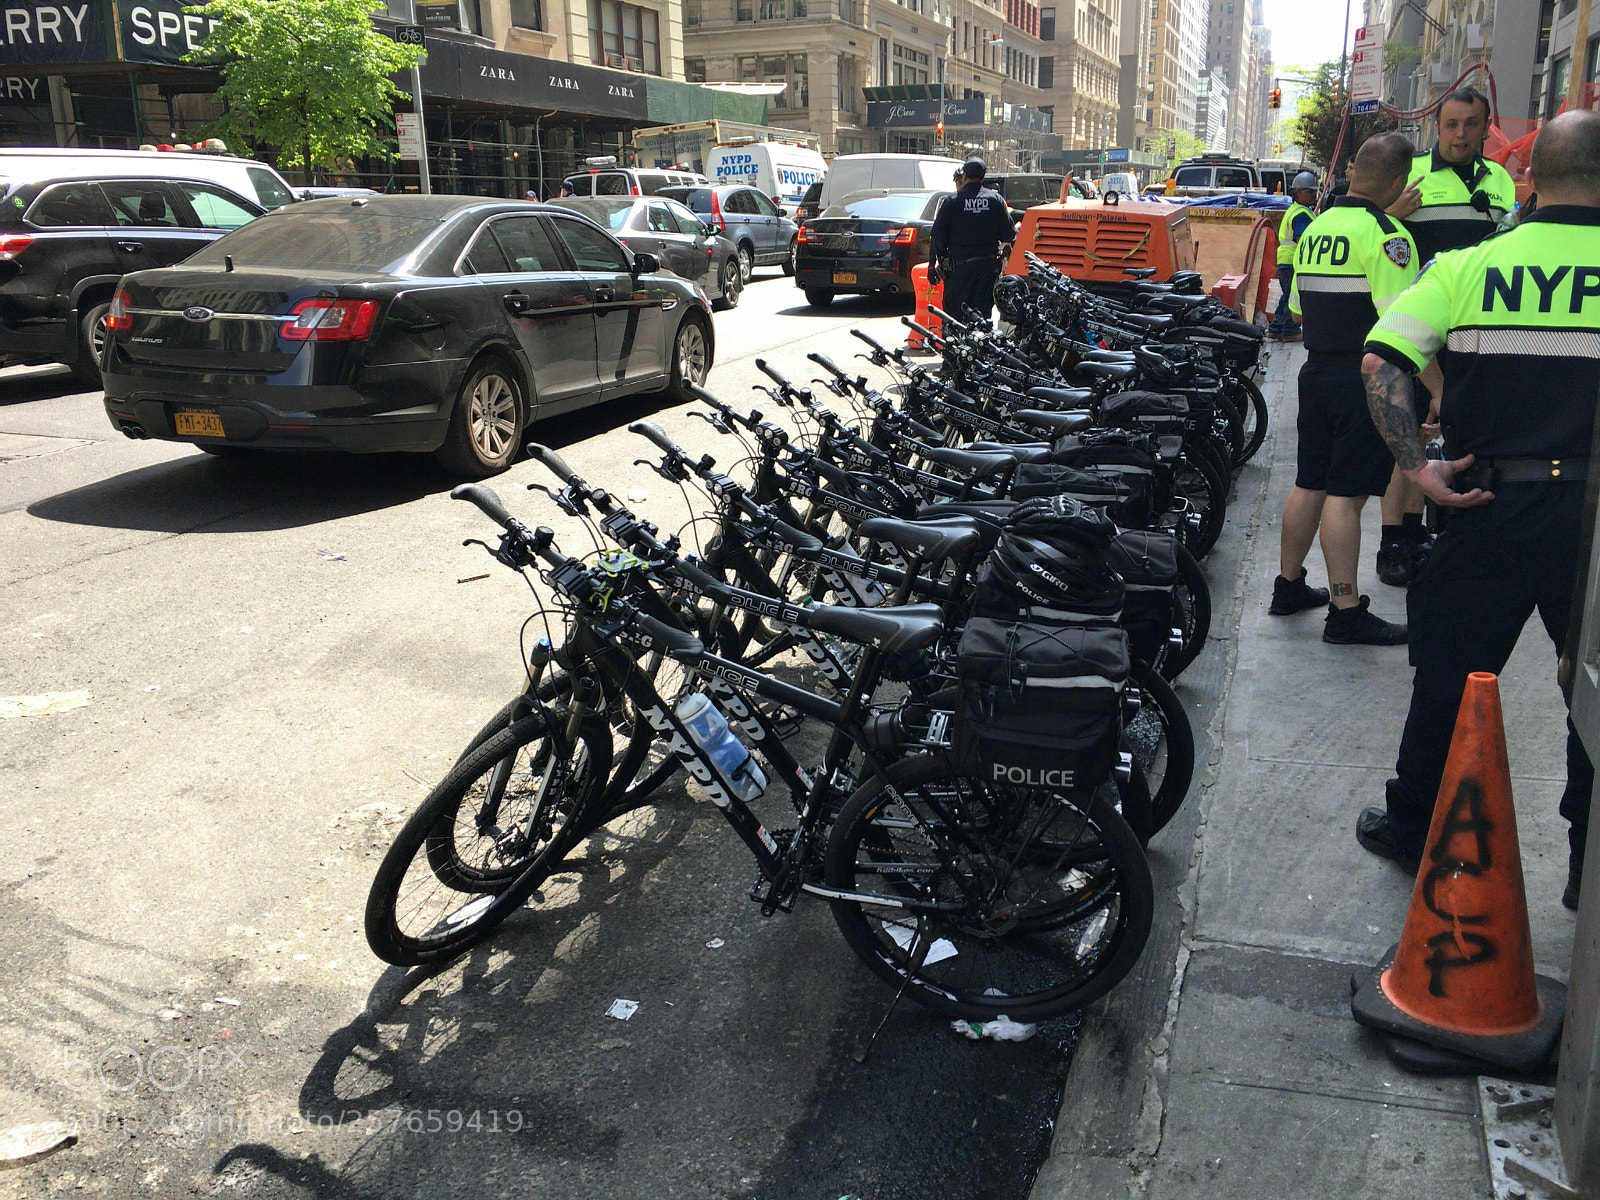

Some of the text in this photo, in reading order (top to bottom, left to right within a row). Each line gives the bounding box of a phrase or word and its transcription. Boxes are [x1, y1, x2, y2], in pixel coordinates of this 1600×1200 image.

[0, 4, 88, 45] RRY
[131, 6, 223, 51] SPE
[479, 65, 516, 81] ZARA
[549, 76, 580, 90] ZARA
[0, 76, 39, 100] RY
[608, 85, 635, 98] ZARA
[721, 154, 752, 165] NYPD
[716, 164, 759, 177] POLICE
[783, 169, 816, 186] POLICE
[964, 198, 989, 208] NYPD
[1299, 234, 1350, 266] NYPD
[1482, 265, 1600, 314] NYP
[849, 453, 873, 467] SRG
[789, 481, 813, 498] SRG
[1015, 580, 1050, 605] POLICE
[696, 658, 760, 692] LICE
[637, 704, 731, 808] NYPD
[993, 762, 1075, 787] POLICE
